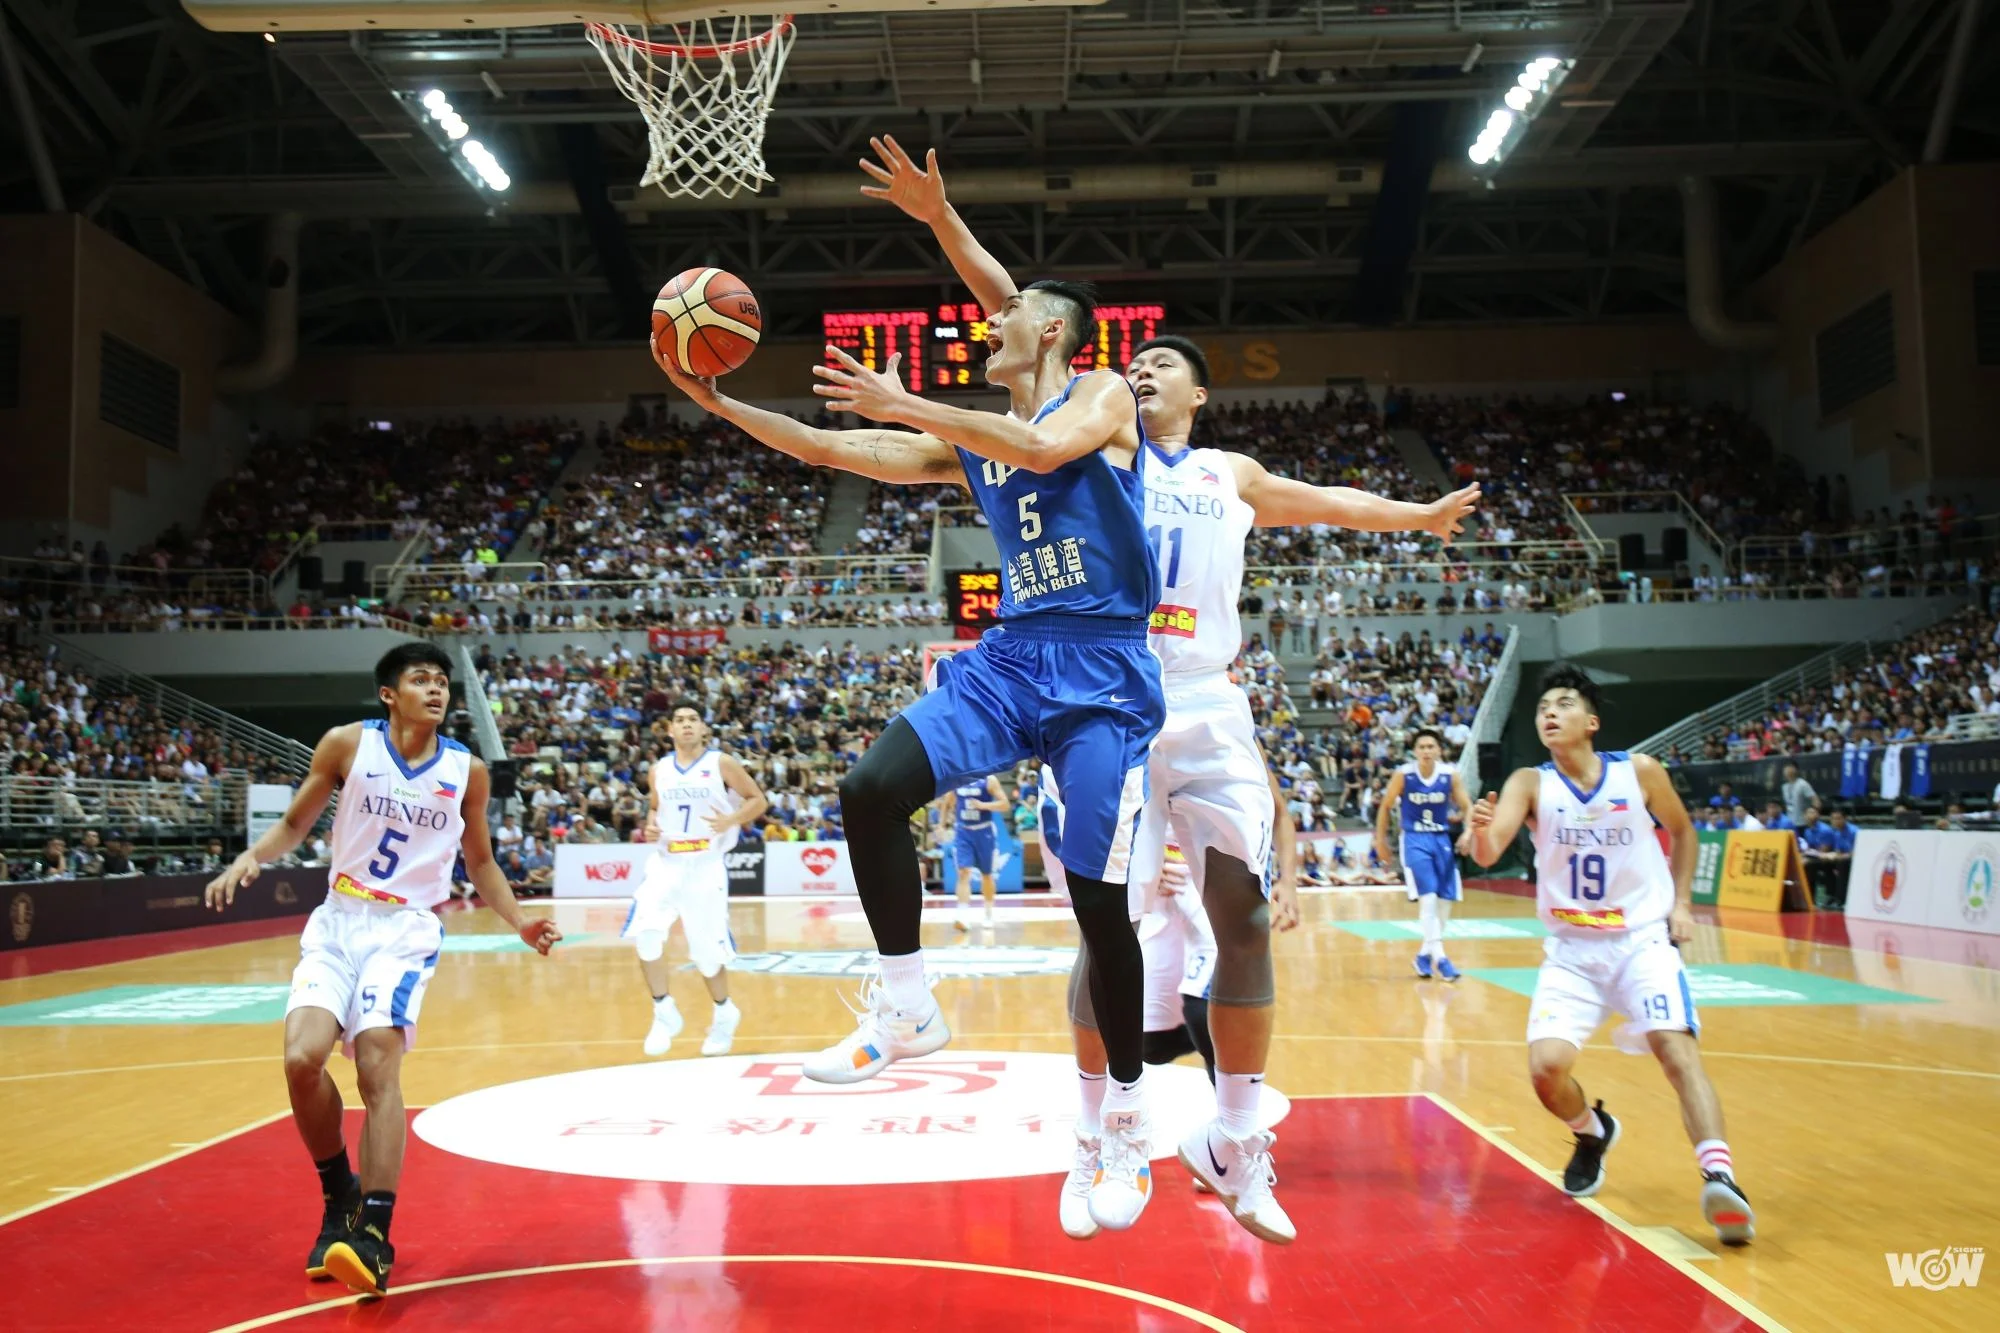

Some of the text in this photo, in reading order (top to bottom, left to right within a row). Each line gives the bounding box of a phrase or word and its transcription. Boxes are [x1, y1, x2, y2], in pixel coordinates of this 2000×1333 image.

[957, 369, 970, 384] 2
[1018, 492, 1043, 542] 5
[1144, 487, 1224, 520] TENEO
[1149, 524, 1183, 589] 11
[1050, 571, 1088, 592] BEER
[961, 593, 1000, 619] 24
[663, 787, 710, 800] ATENEO
[360, 794, 447, 831] ATENEO
[678, 804, 692, 833] 7
[1552, 827, 1634, 847] ATENEO
[368, 826, 410, 880] 5
[1568, 853, 1605, 901] 19
[362, 985, 379, 1014] 5
[1643, 994, 1670, 1020] 19
